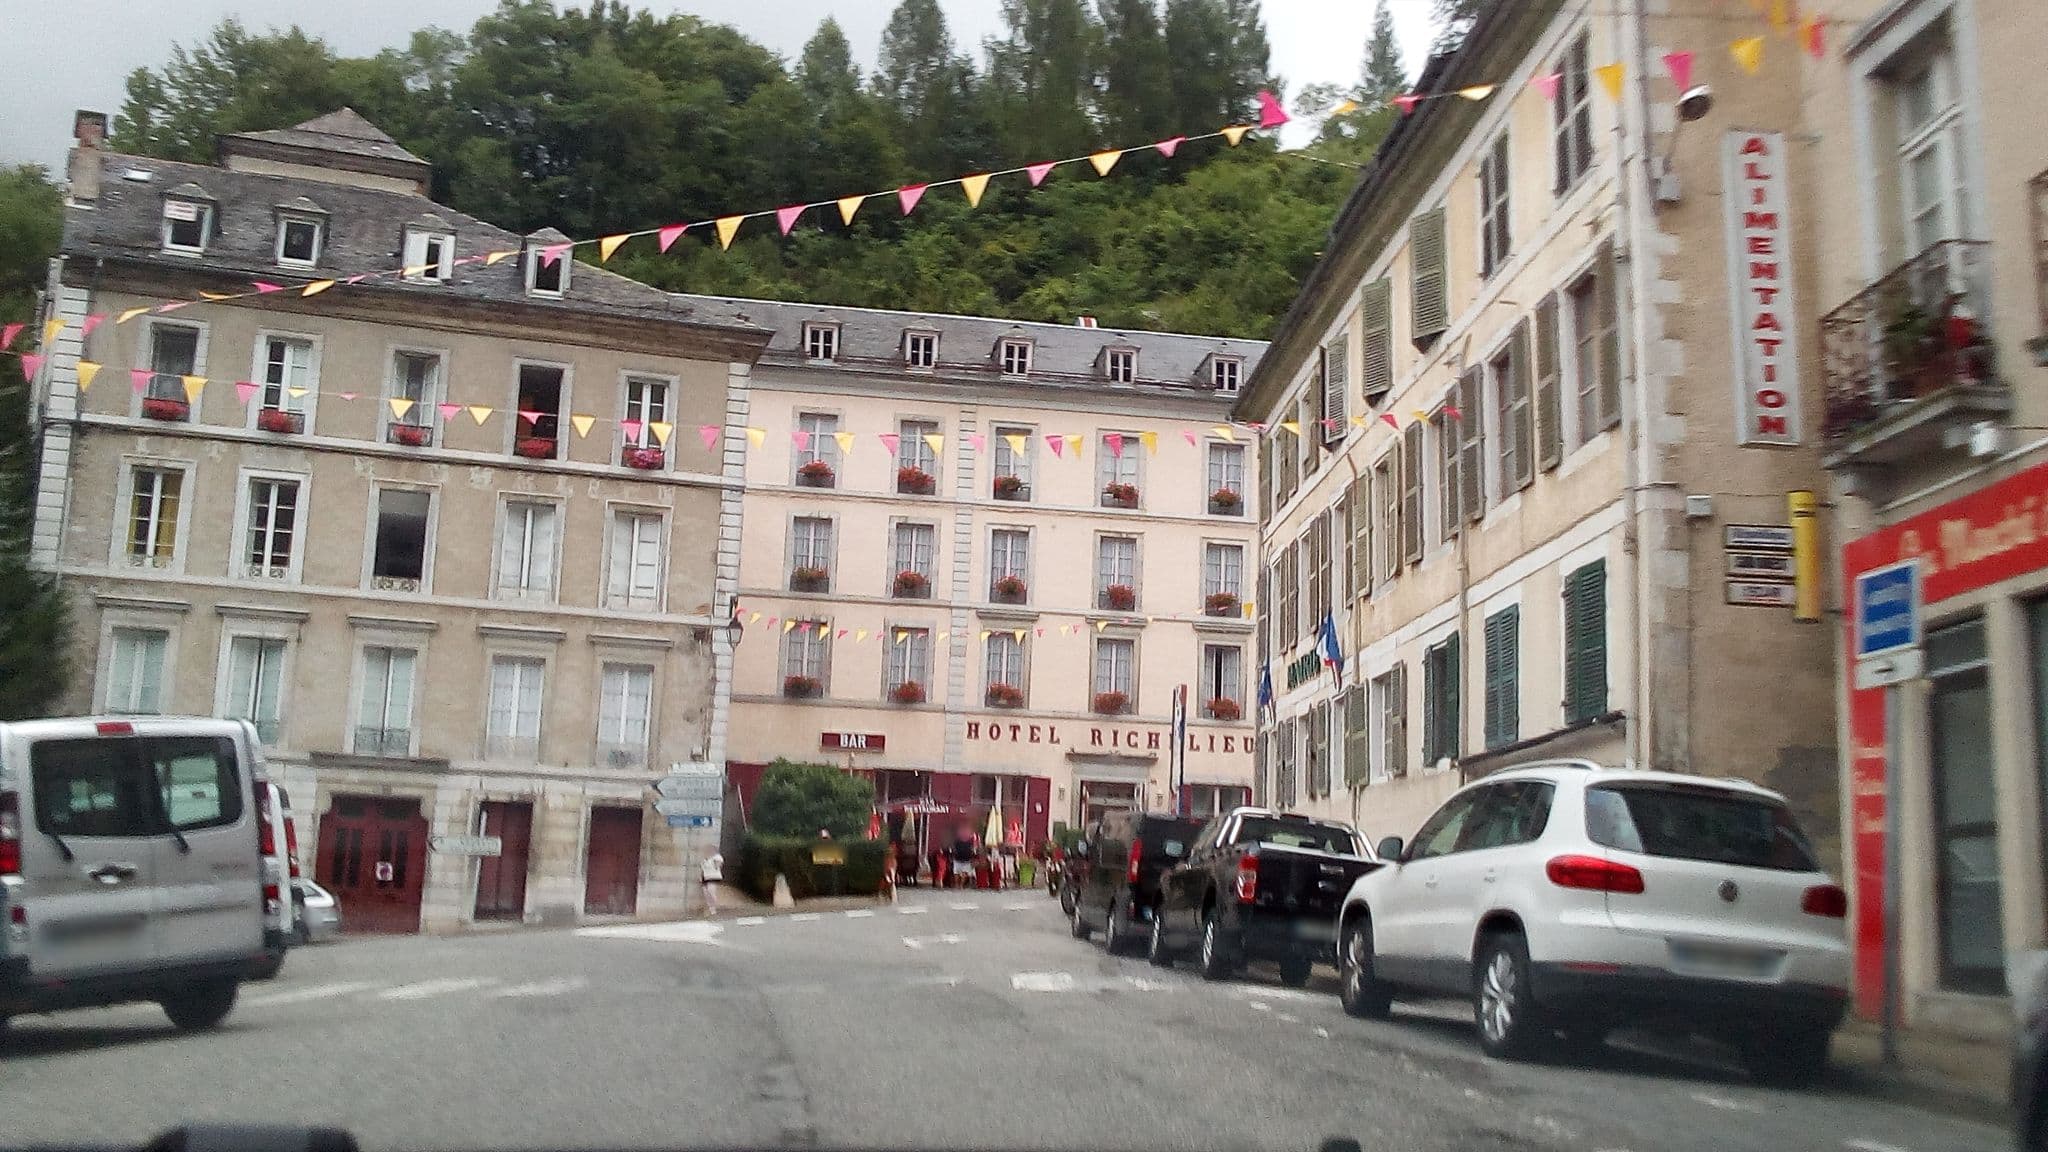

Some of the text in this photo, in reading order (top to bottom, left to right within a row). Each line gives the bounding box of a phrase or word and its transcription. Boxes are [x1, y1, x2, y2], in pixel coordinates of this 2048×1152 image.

[1738, 137, 1788, 435] ALIMENTATION
[840, 733, 866, 749] BAR
[966, 721, 1255, 754] HOTEL RICHLIEU
